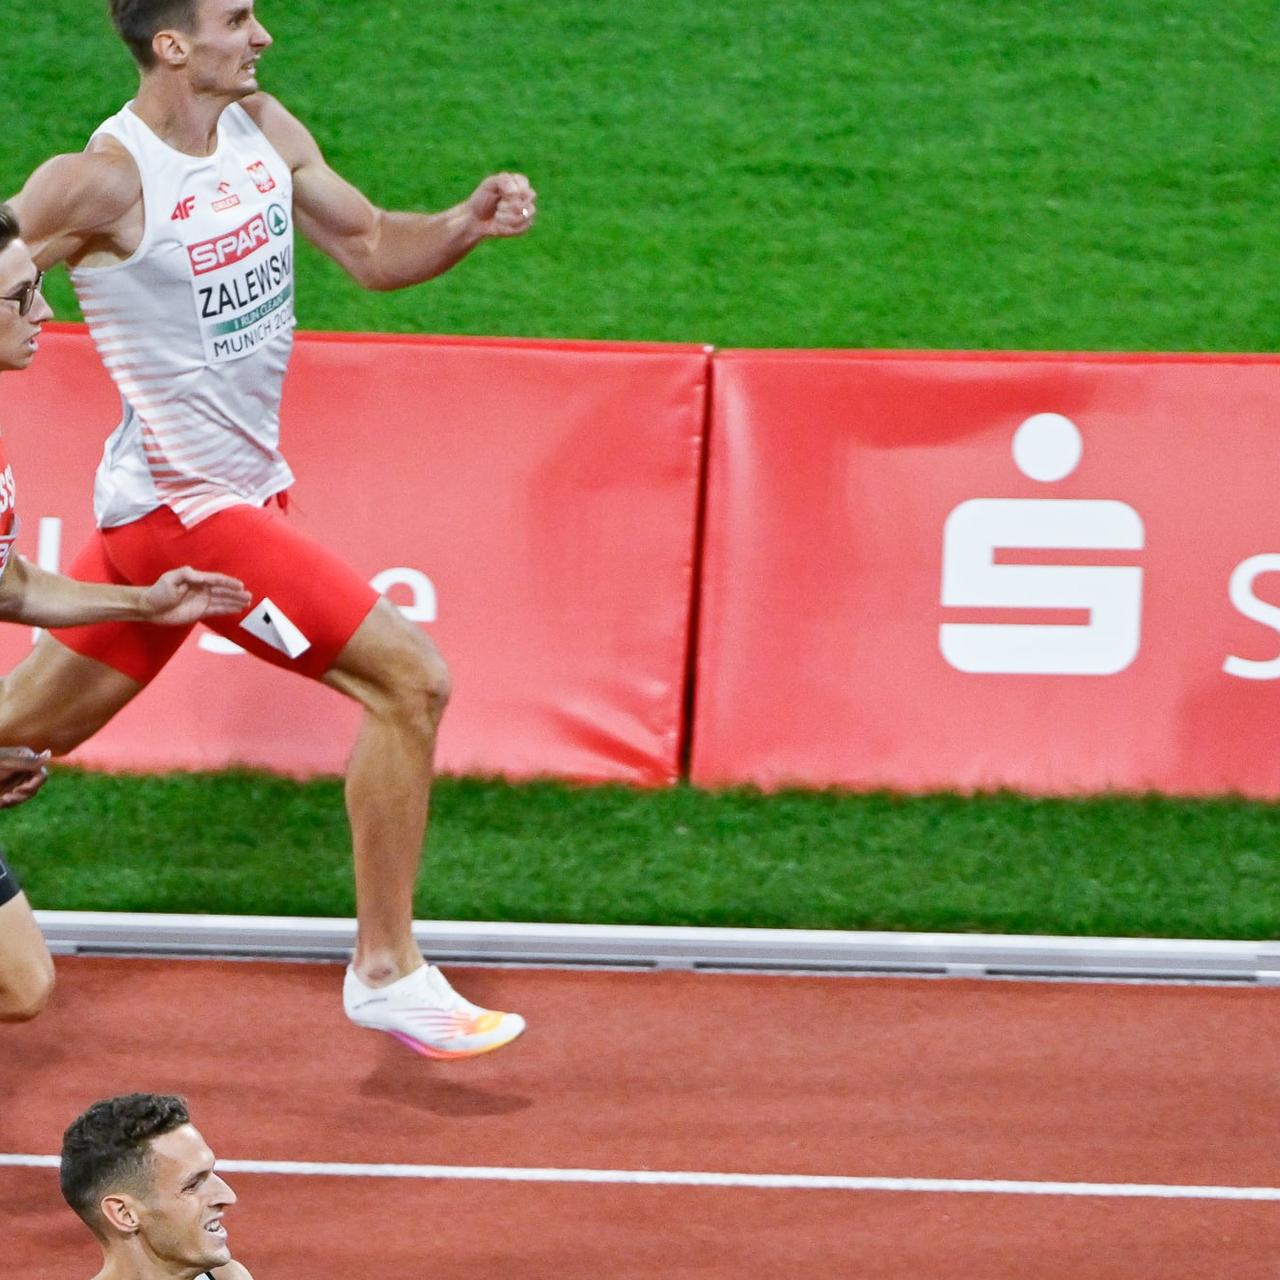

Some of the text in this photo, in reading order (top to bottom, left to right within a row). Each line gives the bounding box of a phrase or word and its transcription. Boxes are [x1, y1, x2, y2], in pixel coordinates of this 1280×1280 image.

[191, 220, 268, 271] SPAR
[199, 244, 291, 318] ZALEWSKI
[214, 319, 271, 357] MUNICH
